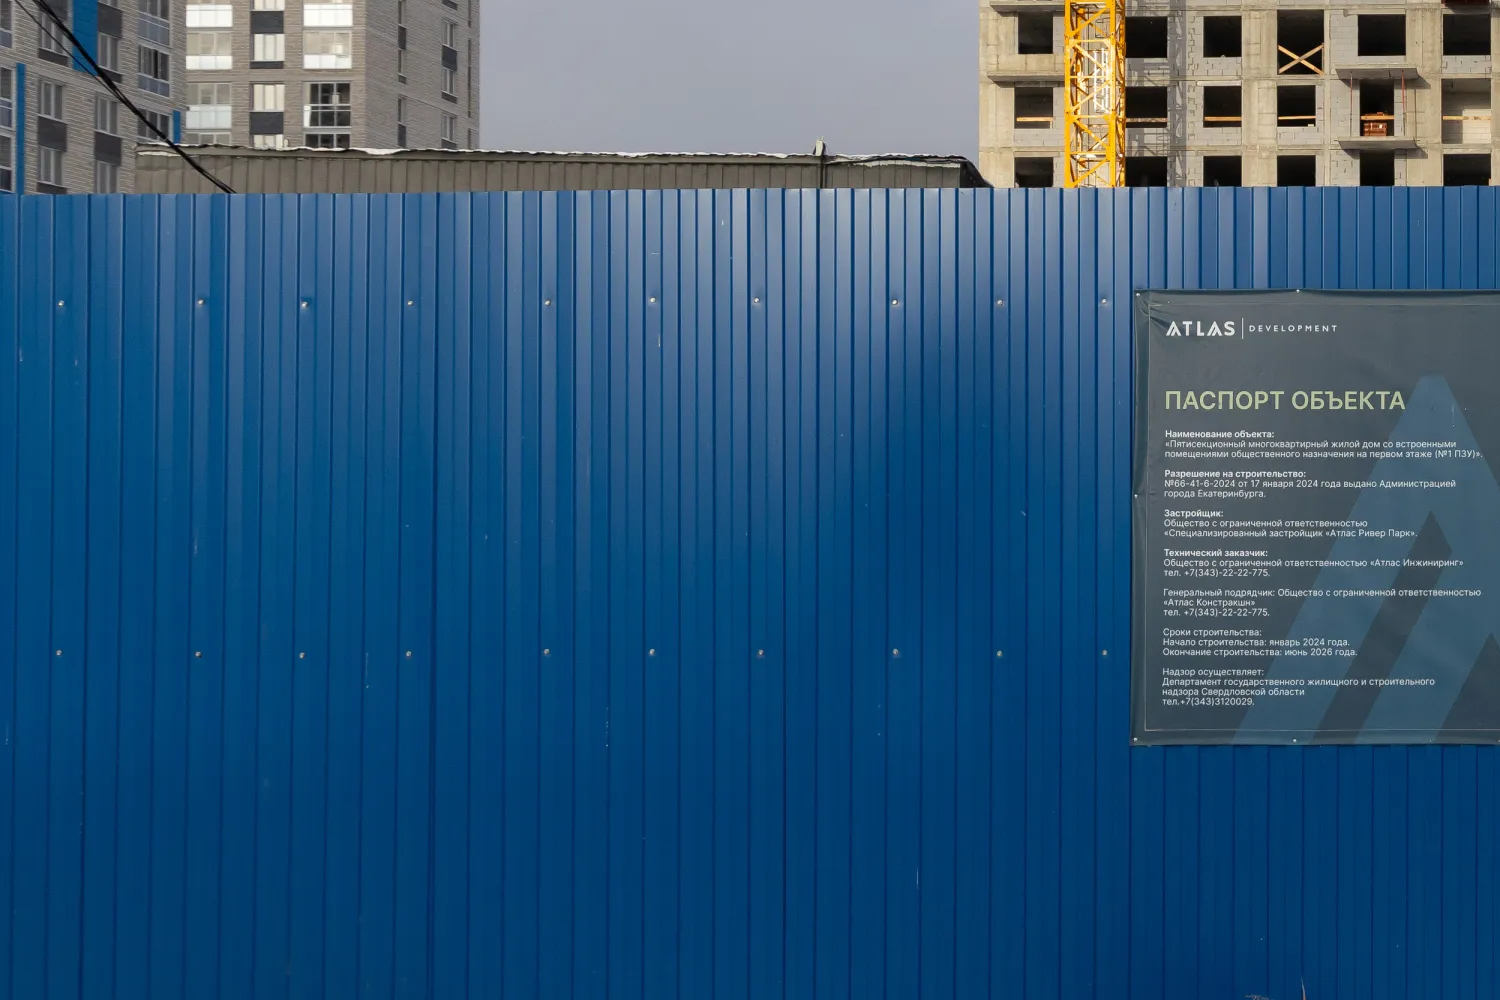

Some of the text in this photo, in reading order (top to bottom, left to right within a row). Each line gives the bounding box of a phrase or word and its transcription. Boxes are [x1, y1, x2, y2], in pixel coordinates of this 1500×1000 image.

[1165, 320, 1338, 337] ATLAS DEVELOPMENT
[1165, 390, 1406, 410] ПАСПОРТ ОБЪЕКТА
[1166, 430, 1274, 438] Наименование объекта:
[1166, 440, 1456, 449] «Пятисекционный многоквартирный жилой дом со встроенными
[1165, 451, 1228, 459] помещениями
[1231, 450, 1300, 459] общественного
[1303, 451, 1354, 459] назначения
[1357, 451, 1367, 459] на
[1370, 451, 1403, 459] первом
[1165, 470, 1221, 479] Разрешение
[1235, 471, 1306, 479] строительство:
[1164, 480, 1456, 489] №66-41-6-2024 от 17 января 2024 года выдано Администрацией
[1164, 490, 1266, 499] города Екатеринбурга.
[1164, 509, 1223, 518] Застройщик:
[1164, 518, 1368, 528] Общество с ограниченной ответственностью
[1164, 529, 1417, 538] «Специализированный застройщик «Атлас Ривер Парк».
[1164, 549, 1222, 557] Технический
[1164, 559, 1463, 568] Общество с ограниченной ответственностью «Атлас Инжиниринг»
[1164, 569, 1270, 577] тел. +7(343)-22-22-775.
[1164, 589, 1481, 598] Генеральный подрядчик: Общество с ограниченной ответственностью
[1164, 598, 1255, 607] «Атлас Констракшн»
[1163, 608, 1270, 617] тел. +7(343)-22-22-775.
[1163, 628, 1261, 637] Сроки строительства:
[1163, 638, 1350, 647] Начало строительства: январь 2024 года.
[1163, 648, 1357, 657] Окончание строительства: июнь 2026 года.
[1163, 668, 1264, 677] Надзор осуществляет:
[1162, 678, 1221, 687] Департамент
[1224, 679, 1304, 687] государственного
[1308, 679, 1358, 687] жилищного
[1369, 679, 1435, 687] строительного
[1162, 688, 1304, 697] надзора Свердловской области
[1162, 697, 1254, 706] тел.+7(343)3120029.
